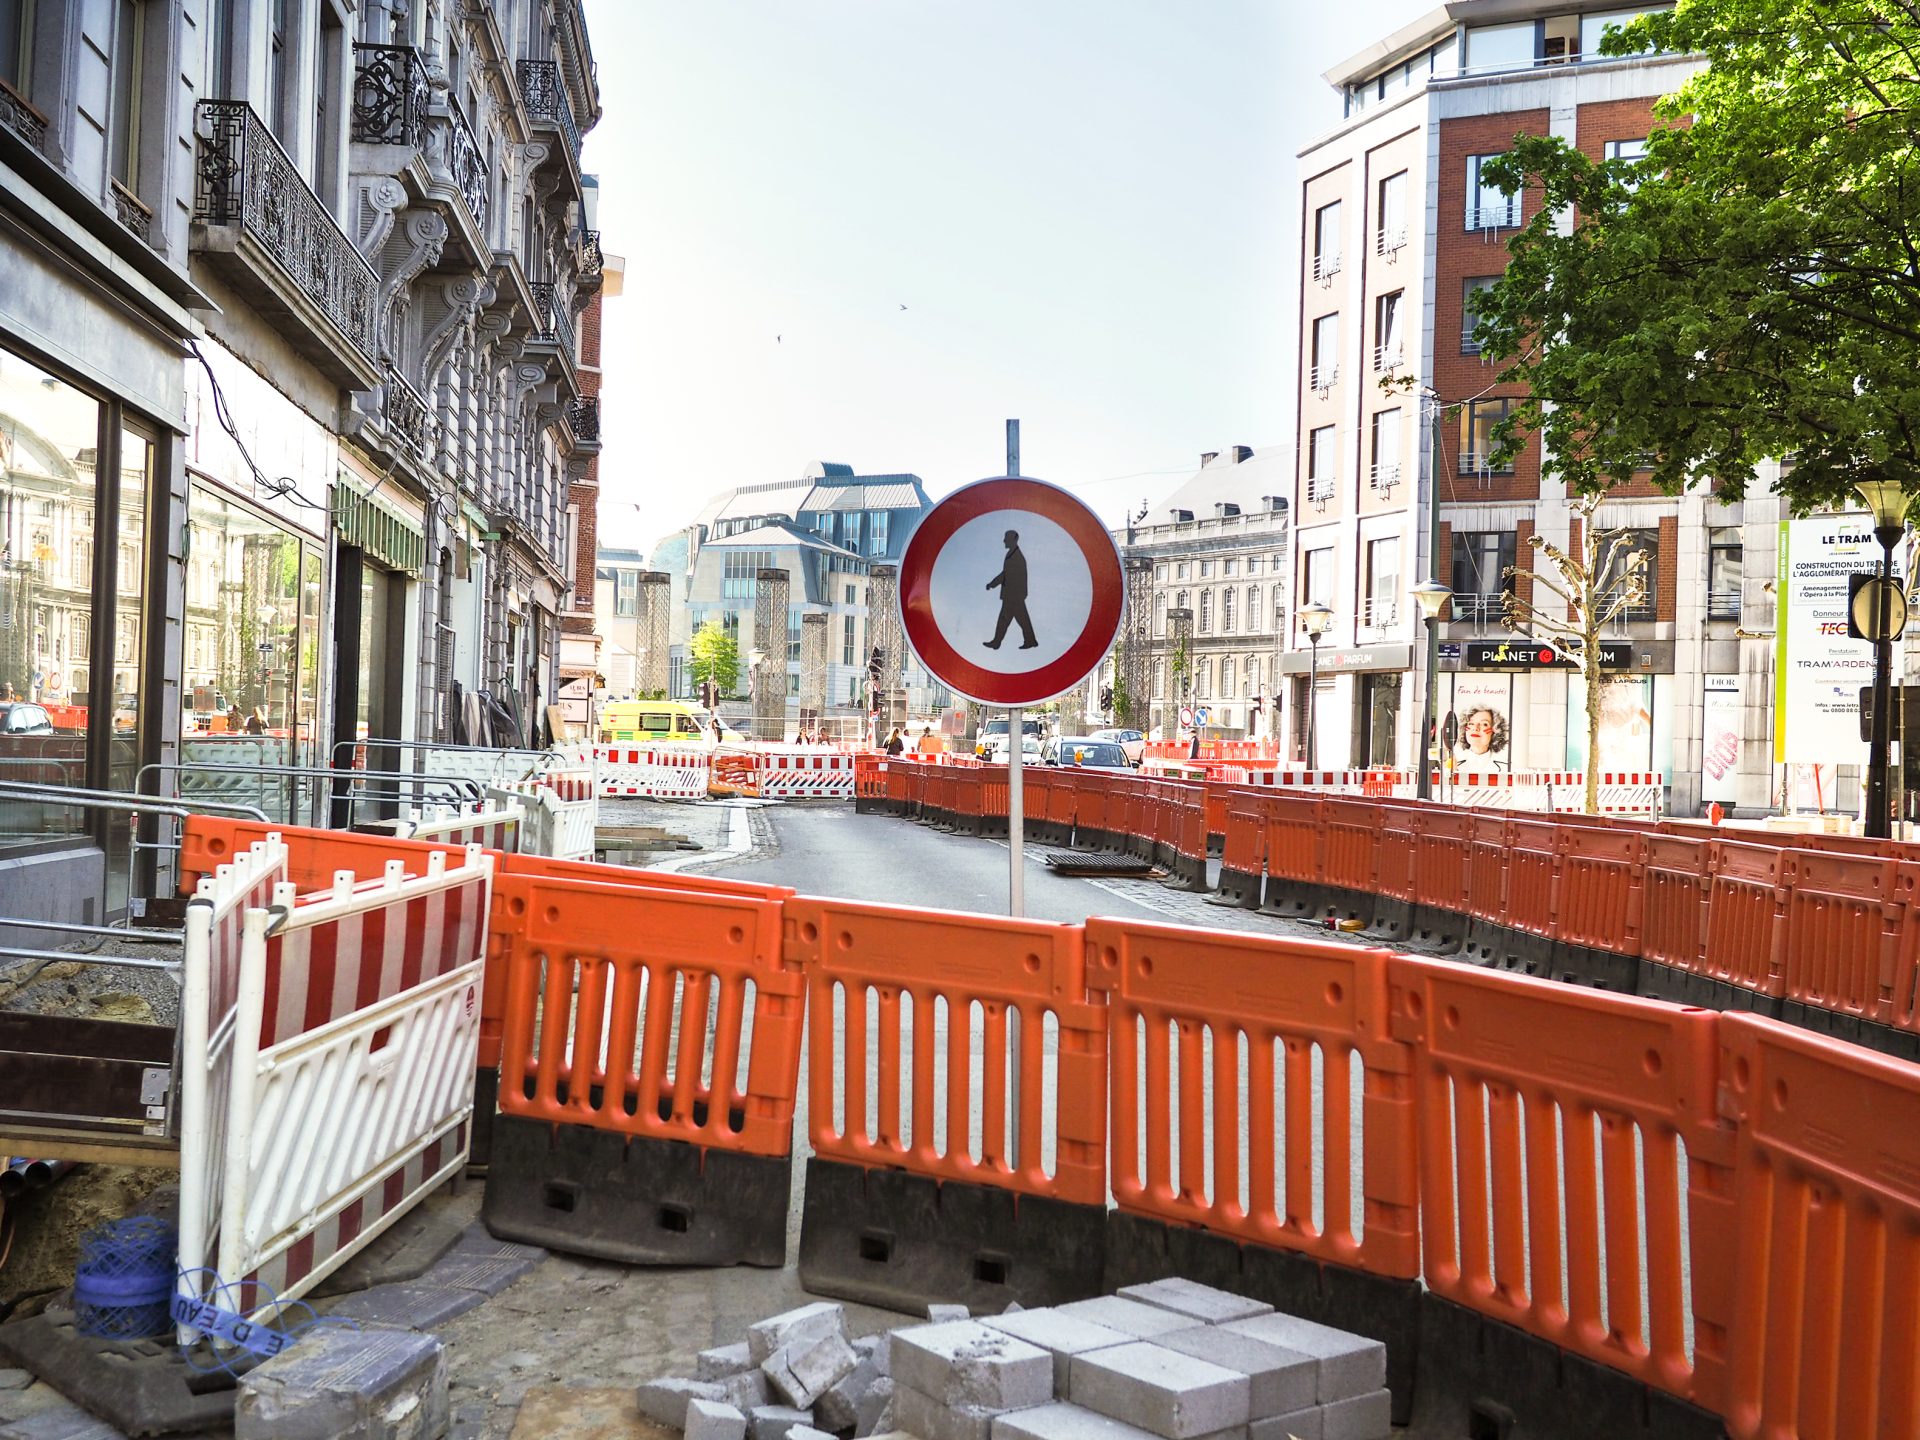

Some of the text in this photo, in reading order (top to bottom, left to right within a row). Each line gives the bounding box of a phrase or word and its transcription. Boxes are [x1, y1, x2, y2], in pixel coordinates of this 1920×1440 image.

[1822, 534, 1872, 544] LE TRAM
[1795, 561, 1852, 570] CONSTRUCTION
[1792, 569, 1862, 577] L'AGGLOMÉRATION
[1820, 622, 1849, 635] TEC
[1343, 653, 1373, 665] PARFUM
[1482, 650, 1538, 662] PLANET
[1797, 660, 1874, 668] TRAM'ARDEN
[1711, 678, 1735, 686] DIOR
[1457, 685, 1471, 695] Fan
[1473, 685, 1481, 694] de
